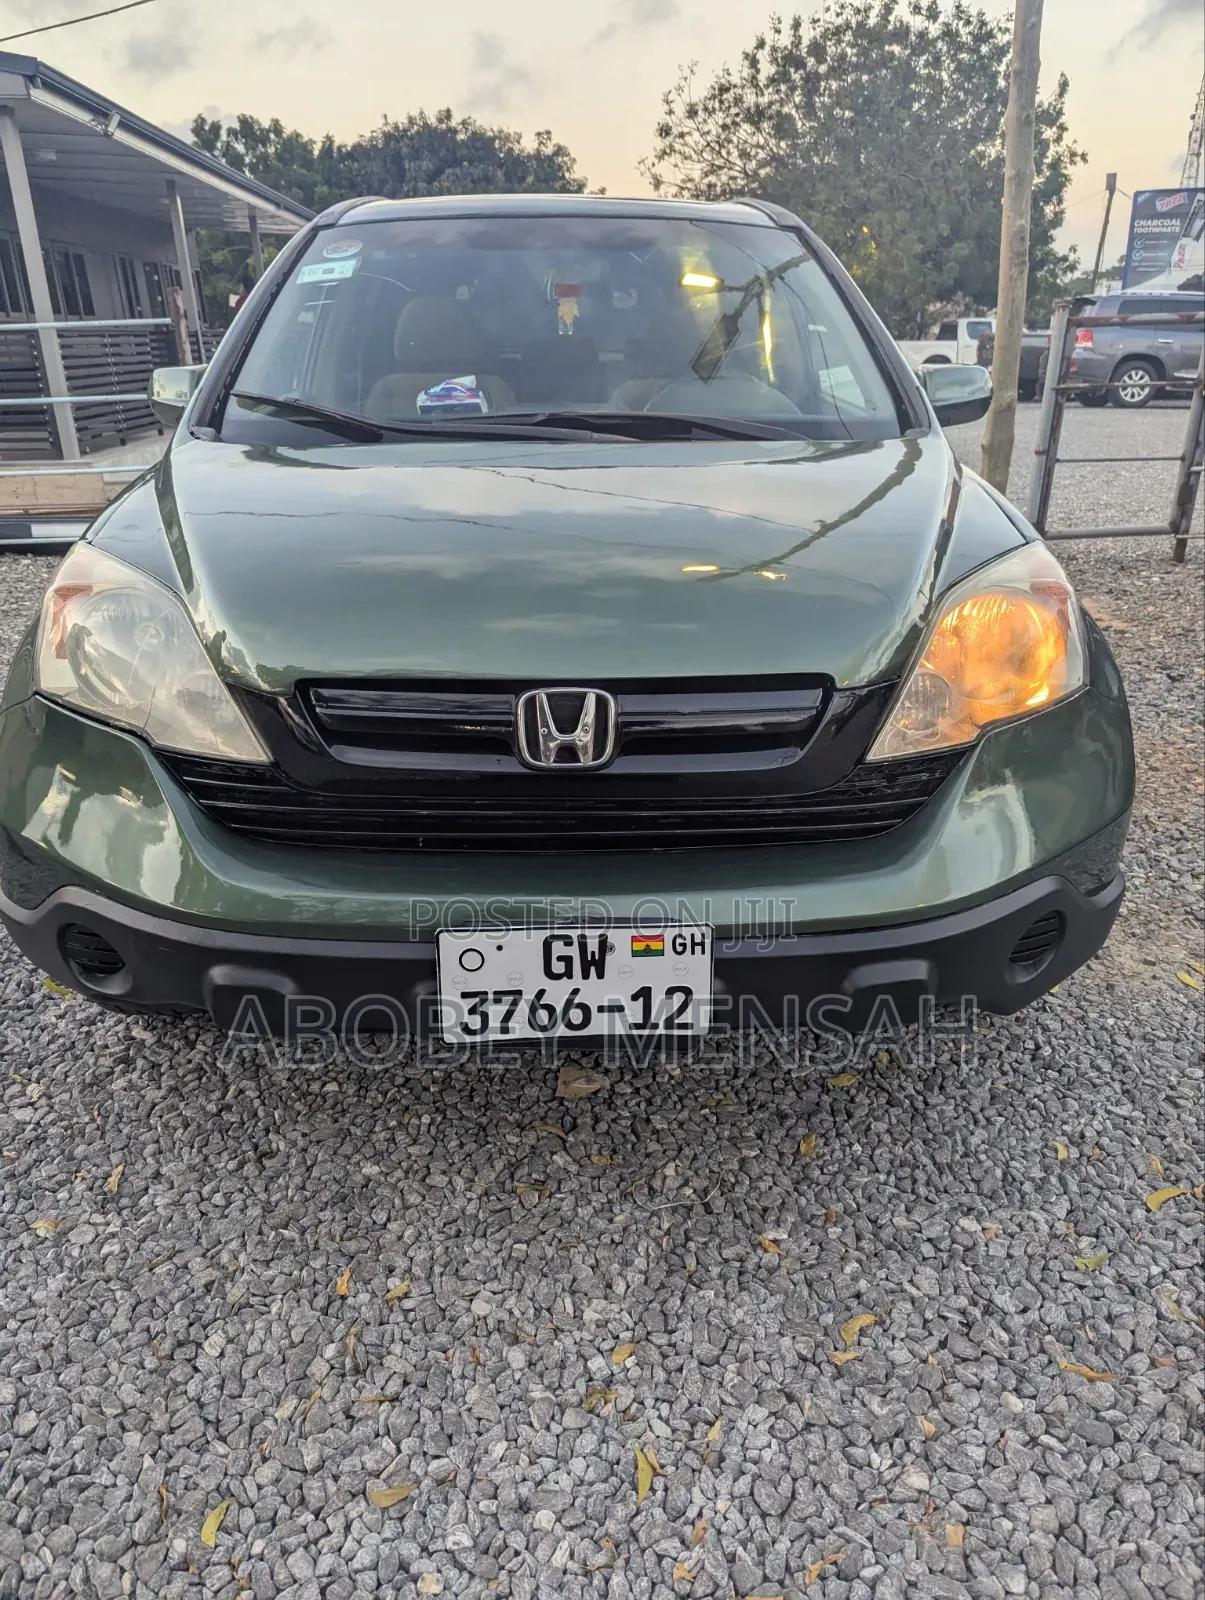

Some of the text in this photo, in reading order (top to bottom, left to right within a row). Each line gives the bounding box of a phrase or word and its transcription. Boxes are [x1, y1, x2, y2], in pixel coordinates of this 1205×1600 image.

[1159, 192, 1184, 209] YAZZ
[542, 933, 608, 981] GW
[671, 932, 706, 956] GH
[459, 985, 694, 1037] 3766-12
